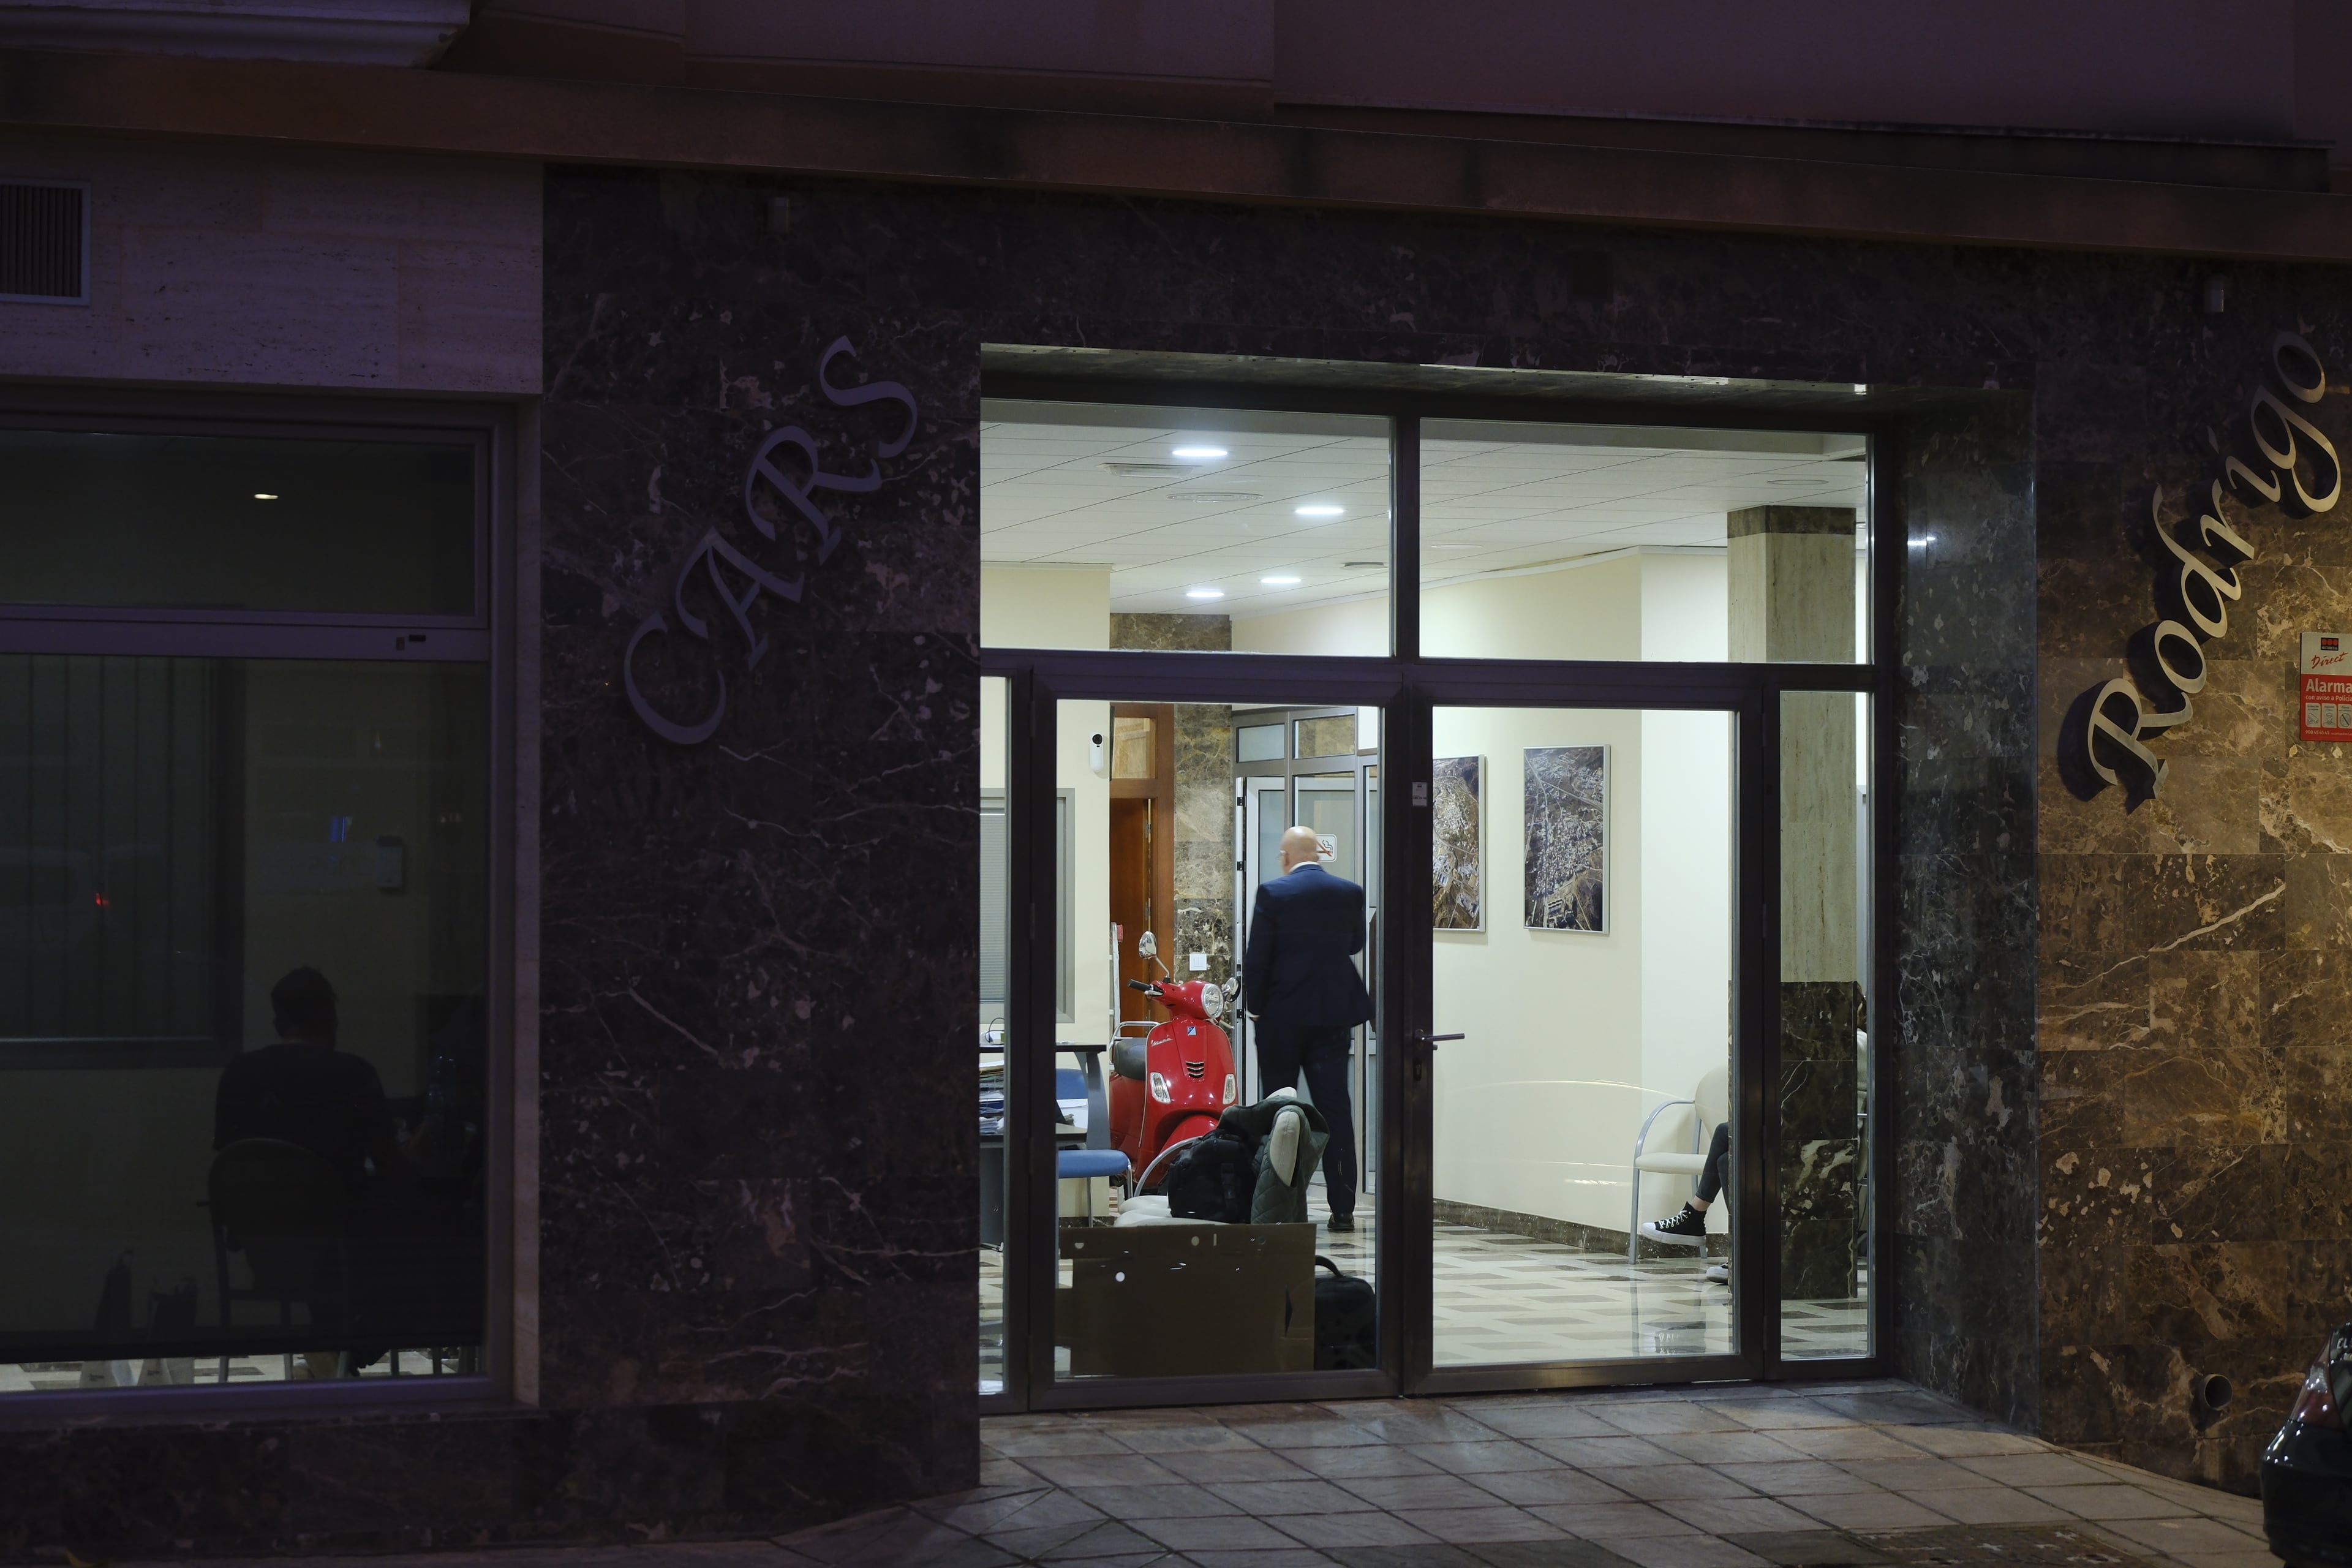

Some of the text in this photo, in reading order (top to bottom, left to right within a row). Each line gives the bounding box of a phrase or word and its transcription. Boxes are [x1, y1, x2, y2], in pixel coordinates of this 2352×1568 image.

[624, 334, 918, 745] CARS
[2089, 330, 2342, 799] Rodrigo
[2305, 677, 2352, 693] Alarma
[2311, 652, 2348, 669] Direct
